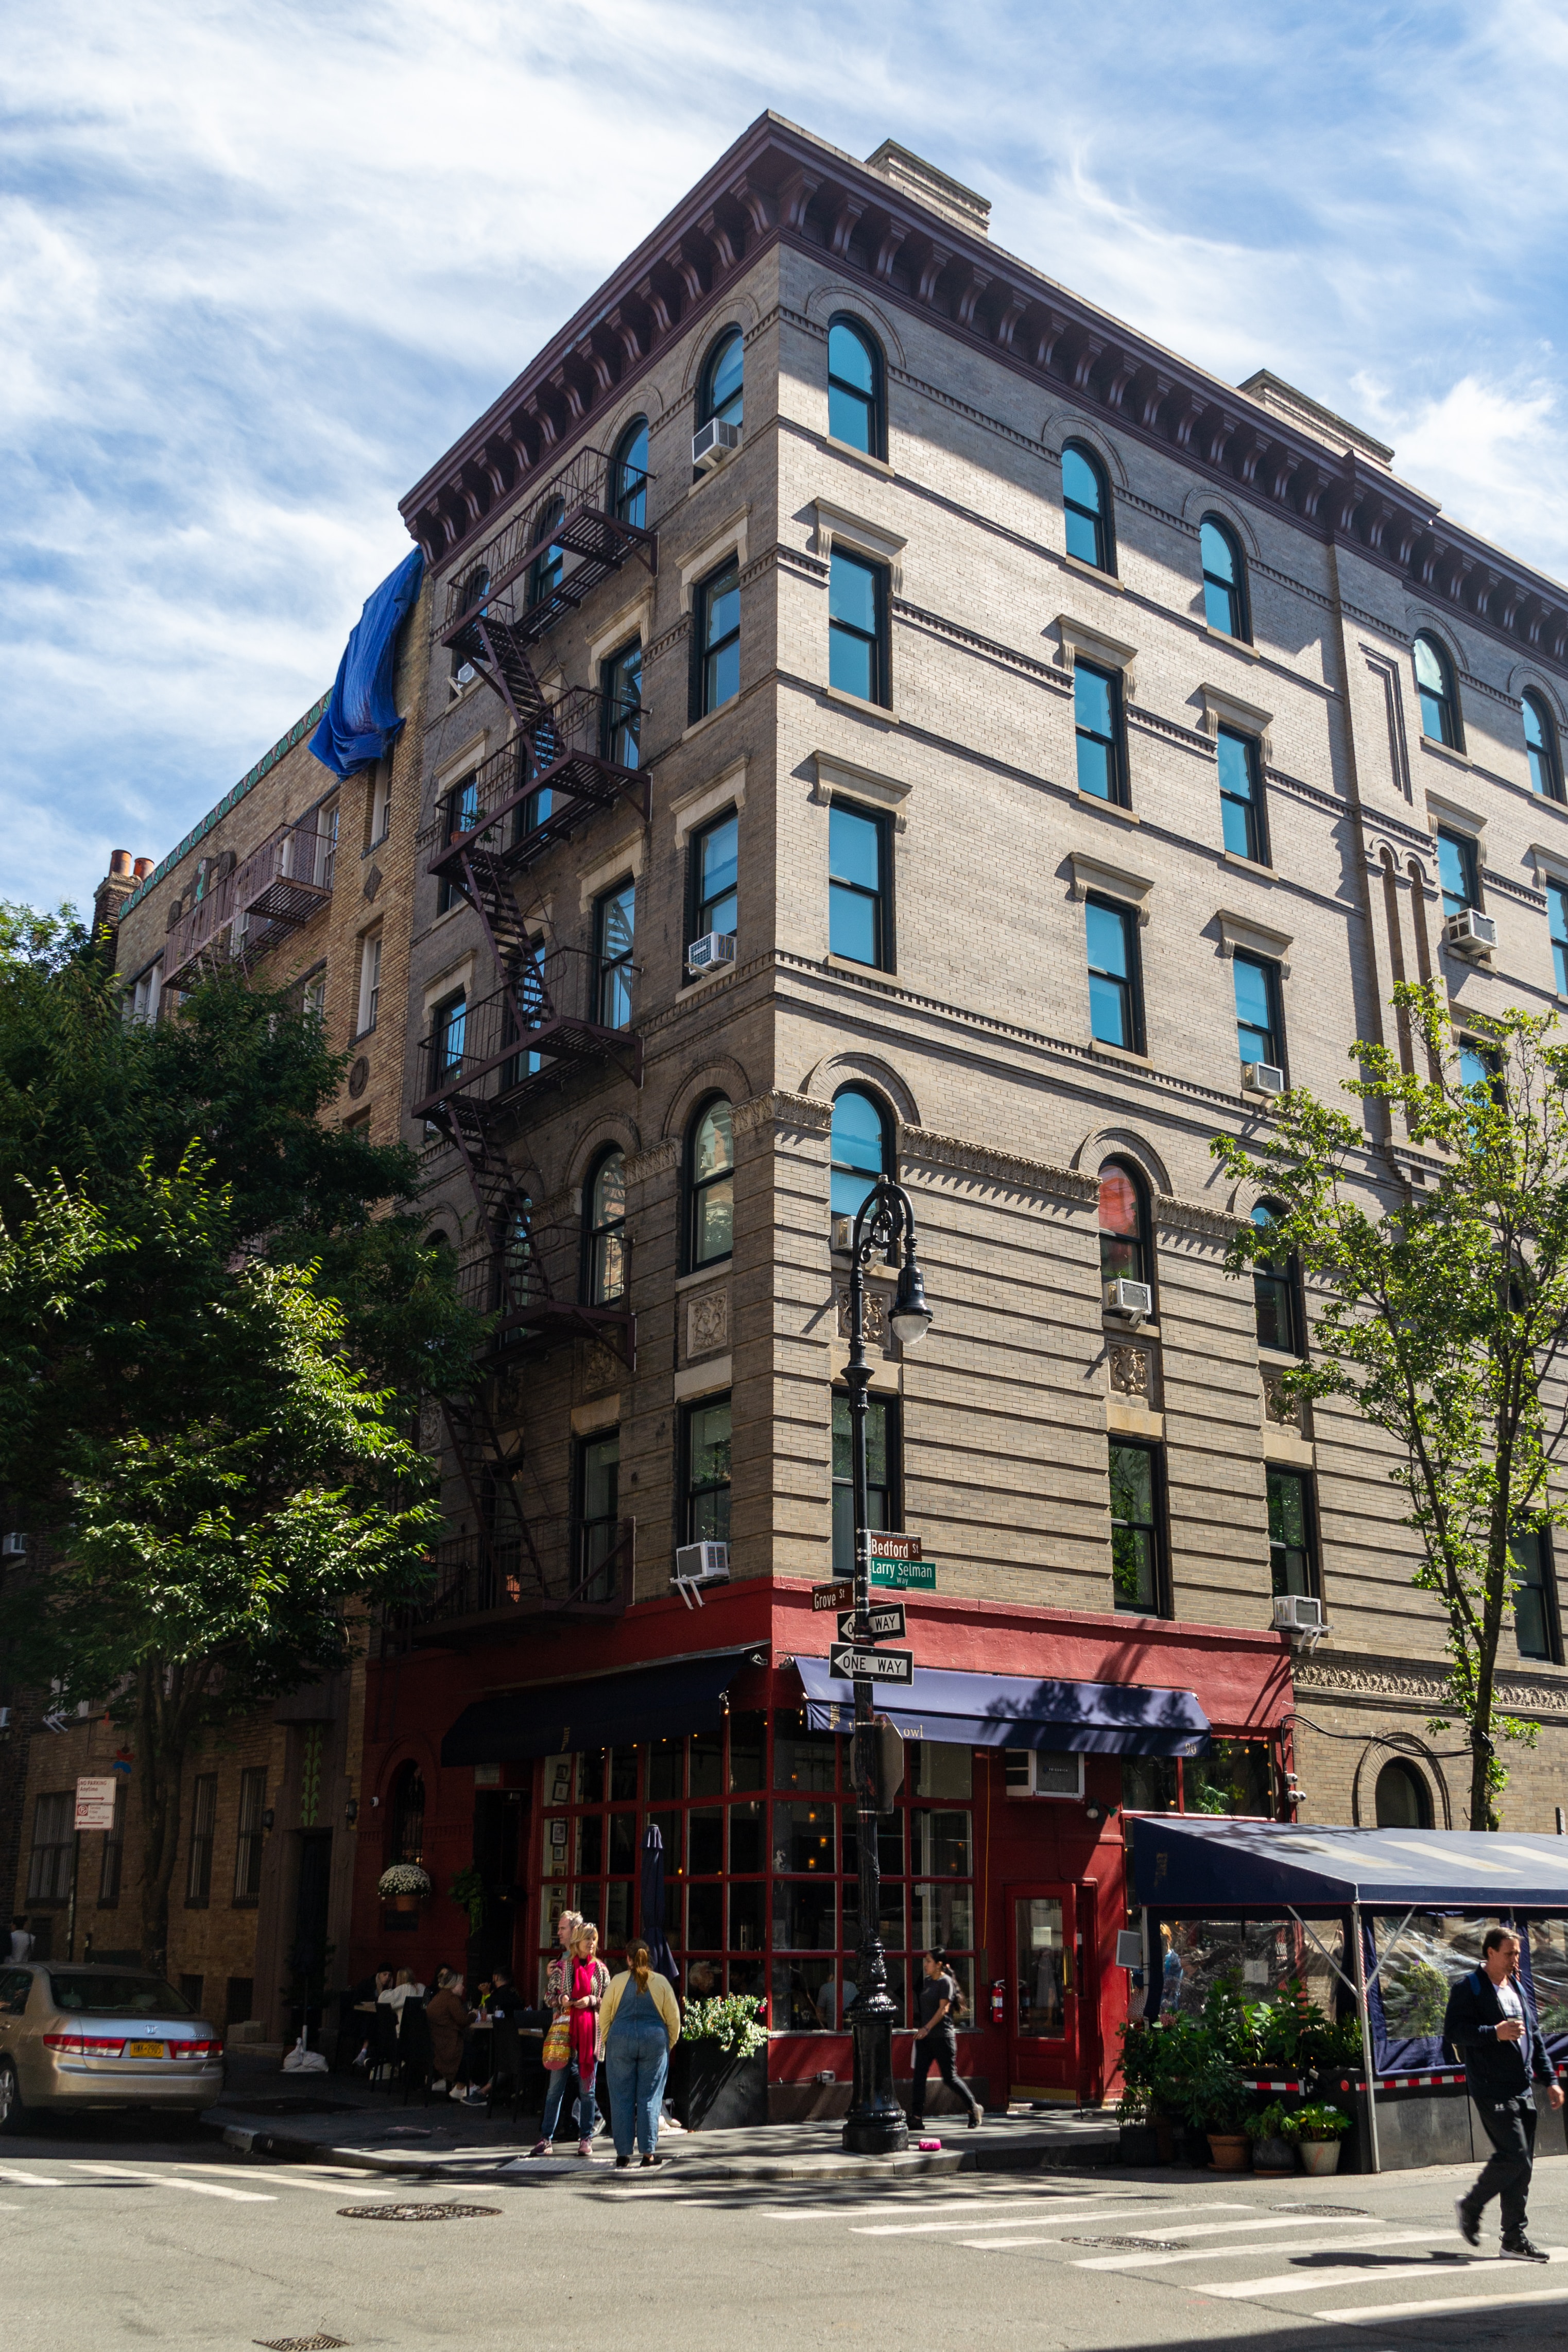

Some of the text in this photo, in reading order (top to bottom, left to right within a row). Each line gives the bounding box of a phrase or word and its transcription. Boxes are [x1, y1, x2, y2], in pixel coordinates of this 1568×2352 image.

[871, 1538, 919, 1558] Bedford St
[872, 1560, 932, 1578] Larry Selman
[897, 1577, 908, 1586] Way
[814, 1589, 845, 1609] Grove St
[875, 1616, 895, 1630] WAY
[843, 1656, 902, 1673] ONE WAY
[903, 1725, 924, 1738] owl
[1185, 1743, 1197, 1755] 90
